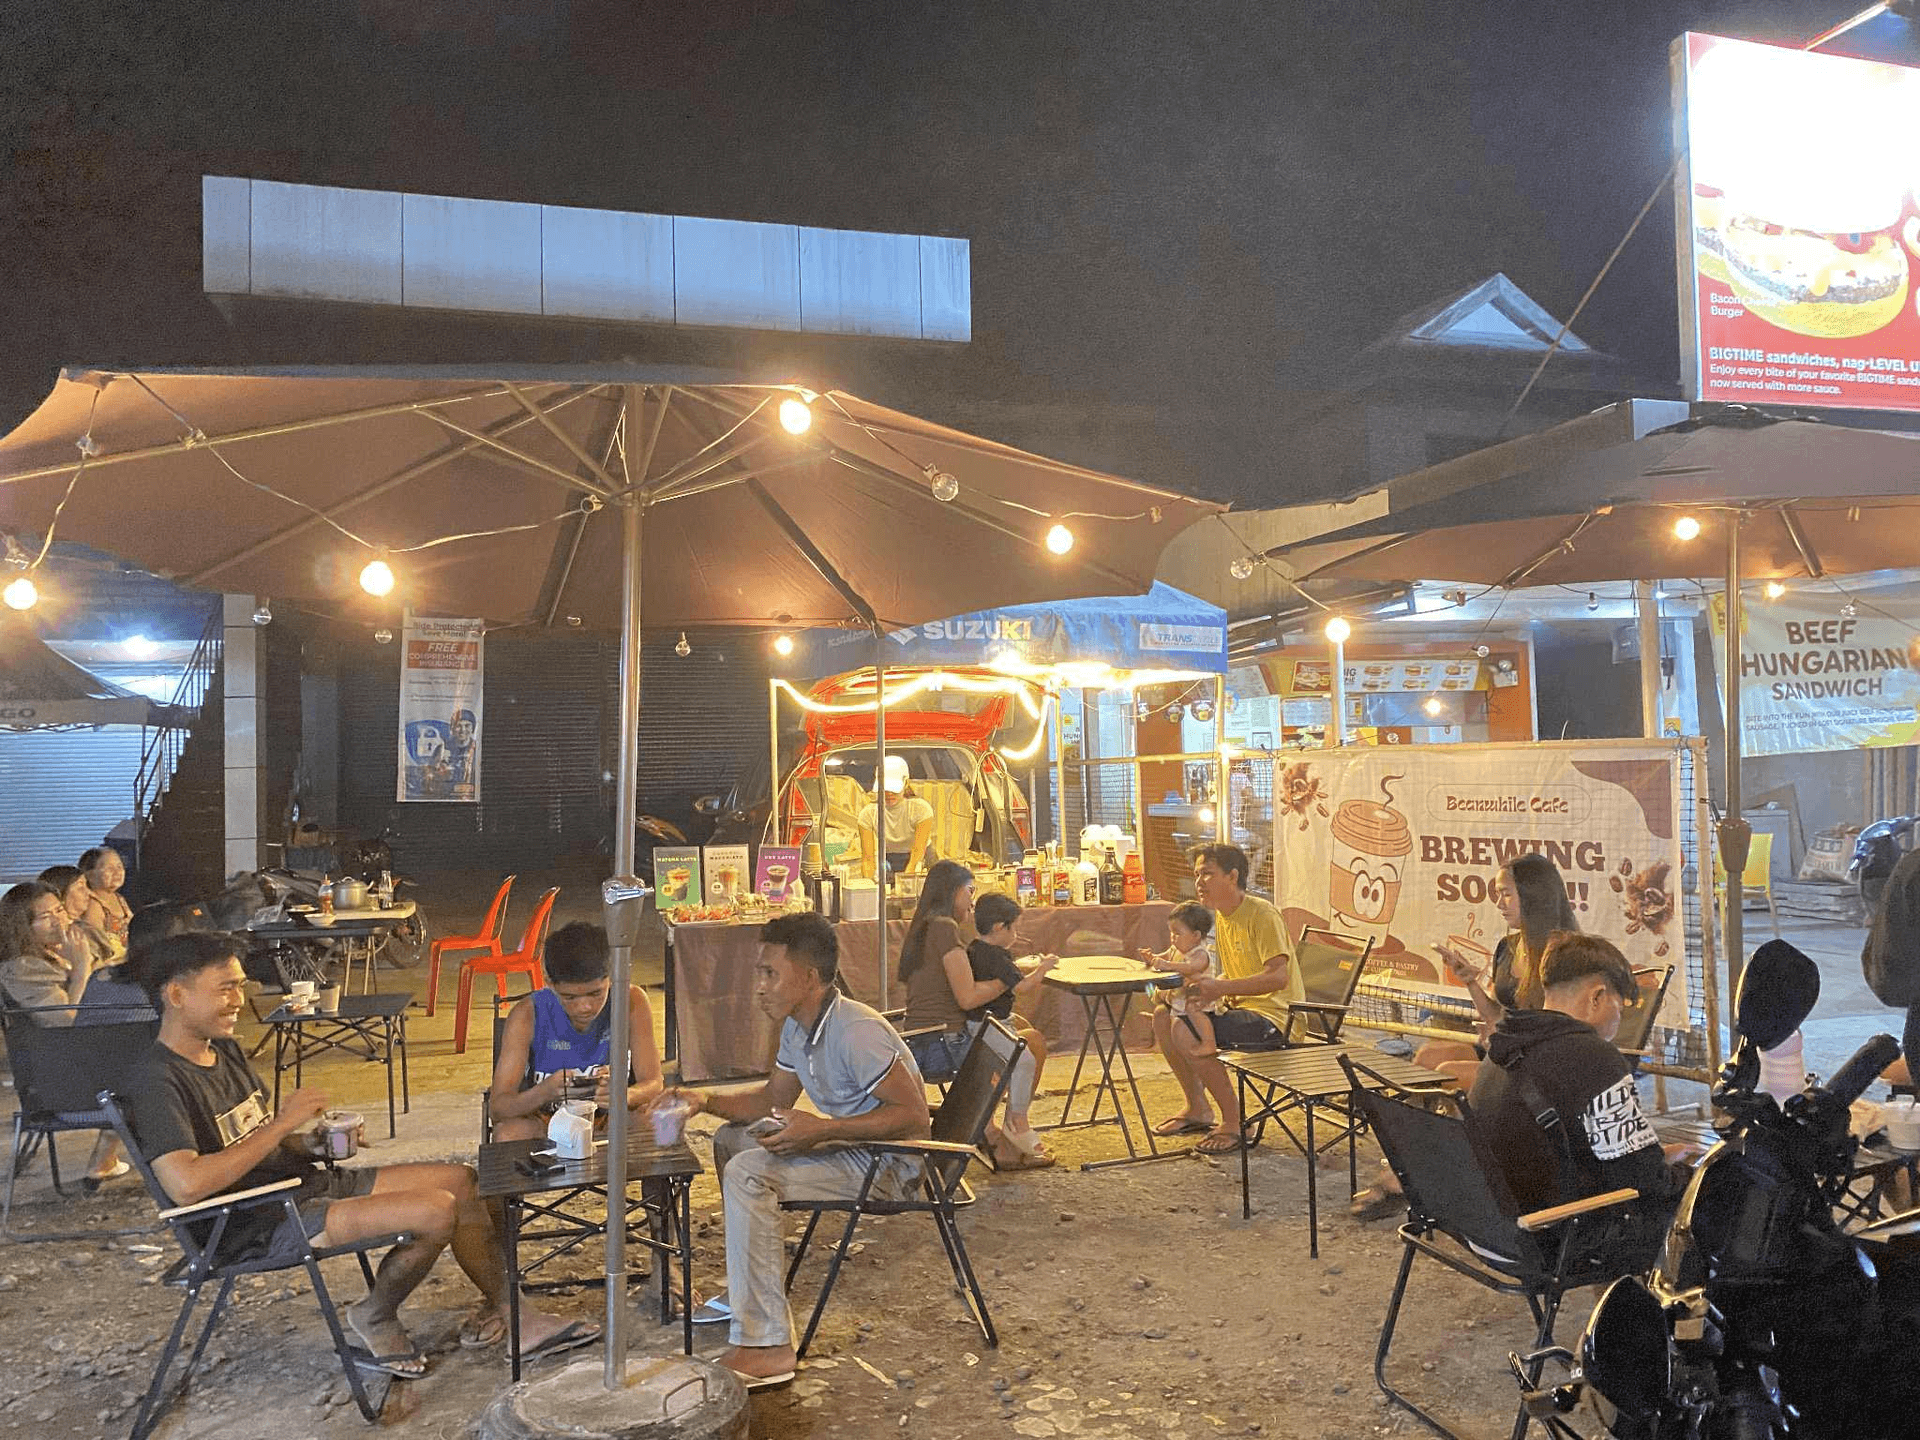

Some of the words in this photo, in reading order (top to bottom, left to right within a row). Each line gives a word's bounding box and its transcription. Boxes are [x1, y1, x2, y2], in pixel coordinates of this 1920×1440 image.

[1710, 293, 1741, 304] Bacon
[1710, 306, 1744, 318] Burger
[1709, 347, 1764, 362] BIGTIME
[1766, 352, 1840, 369] sandwiches,
[1842, 357, 1908, 371] nag-LEVEL
[1710, 364, 1736, 375] Enjoy
[1737, 367, 1764, 377] every
[1765, 367, 1785, 377] bite
[1786, 369, 1797, 377] of
[1797, 371, 1819, 380] your
[1820, 371, 1857, 381] favorite
[1857, 373, 1896, 384] BIGTIME
[1732, 380, 1764, 389] served
[1765, 381, 1786, 390] with
[1787, 383, 1812, 392] more
[1813, 385, 1842, 394] sauce.
[923, 619, 1033, 641] SUZUKI
[1785, 620, 1857, 645] BEEF
[427, 642, 459, 653] FREE
[1741, 647, 1909, 678] HUNGARIAN
[1771, 677, 1883, 701] SANDWICH
[1446, 796, 1527, 812] Beanwhile
[1530, 797, 1569, 813] Cafe
[1420, 835, 1606, 872] BREWING
